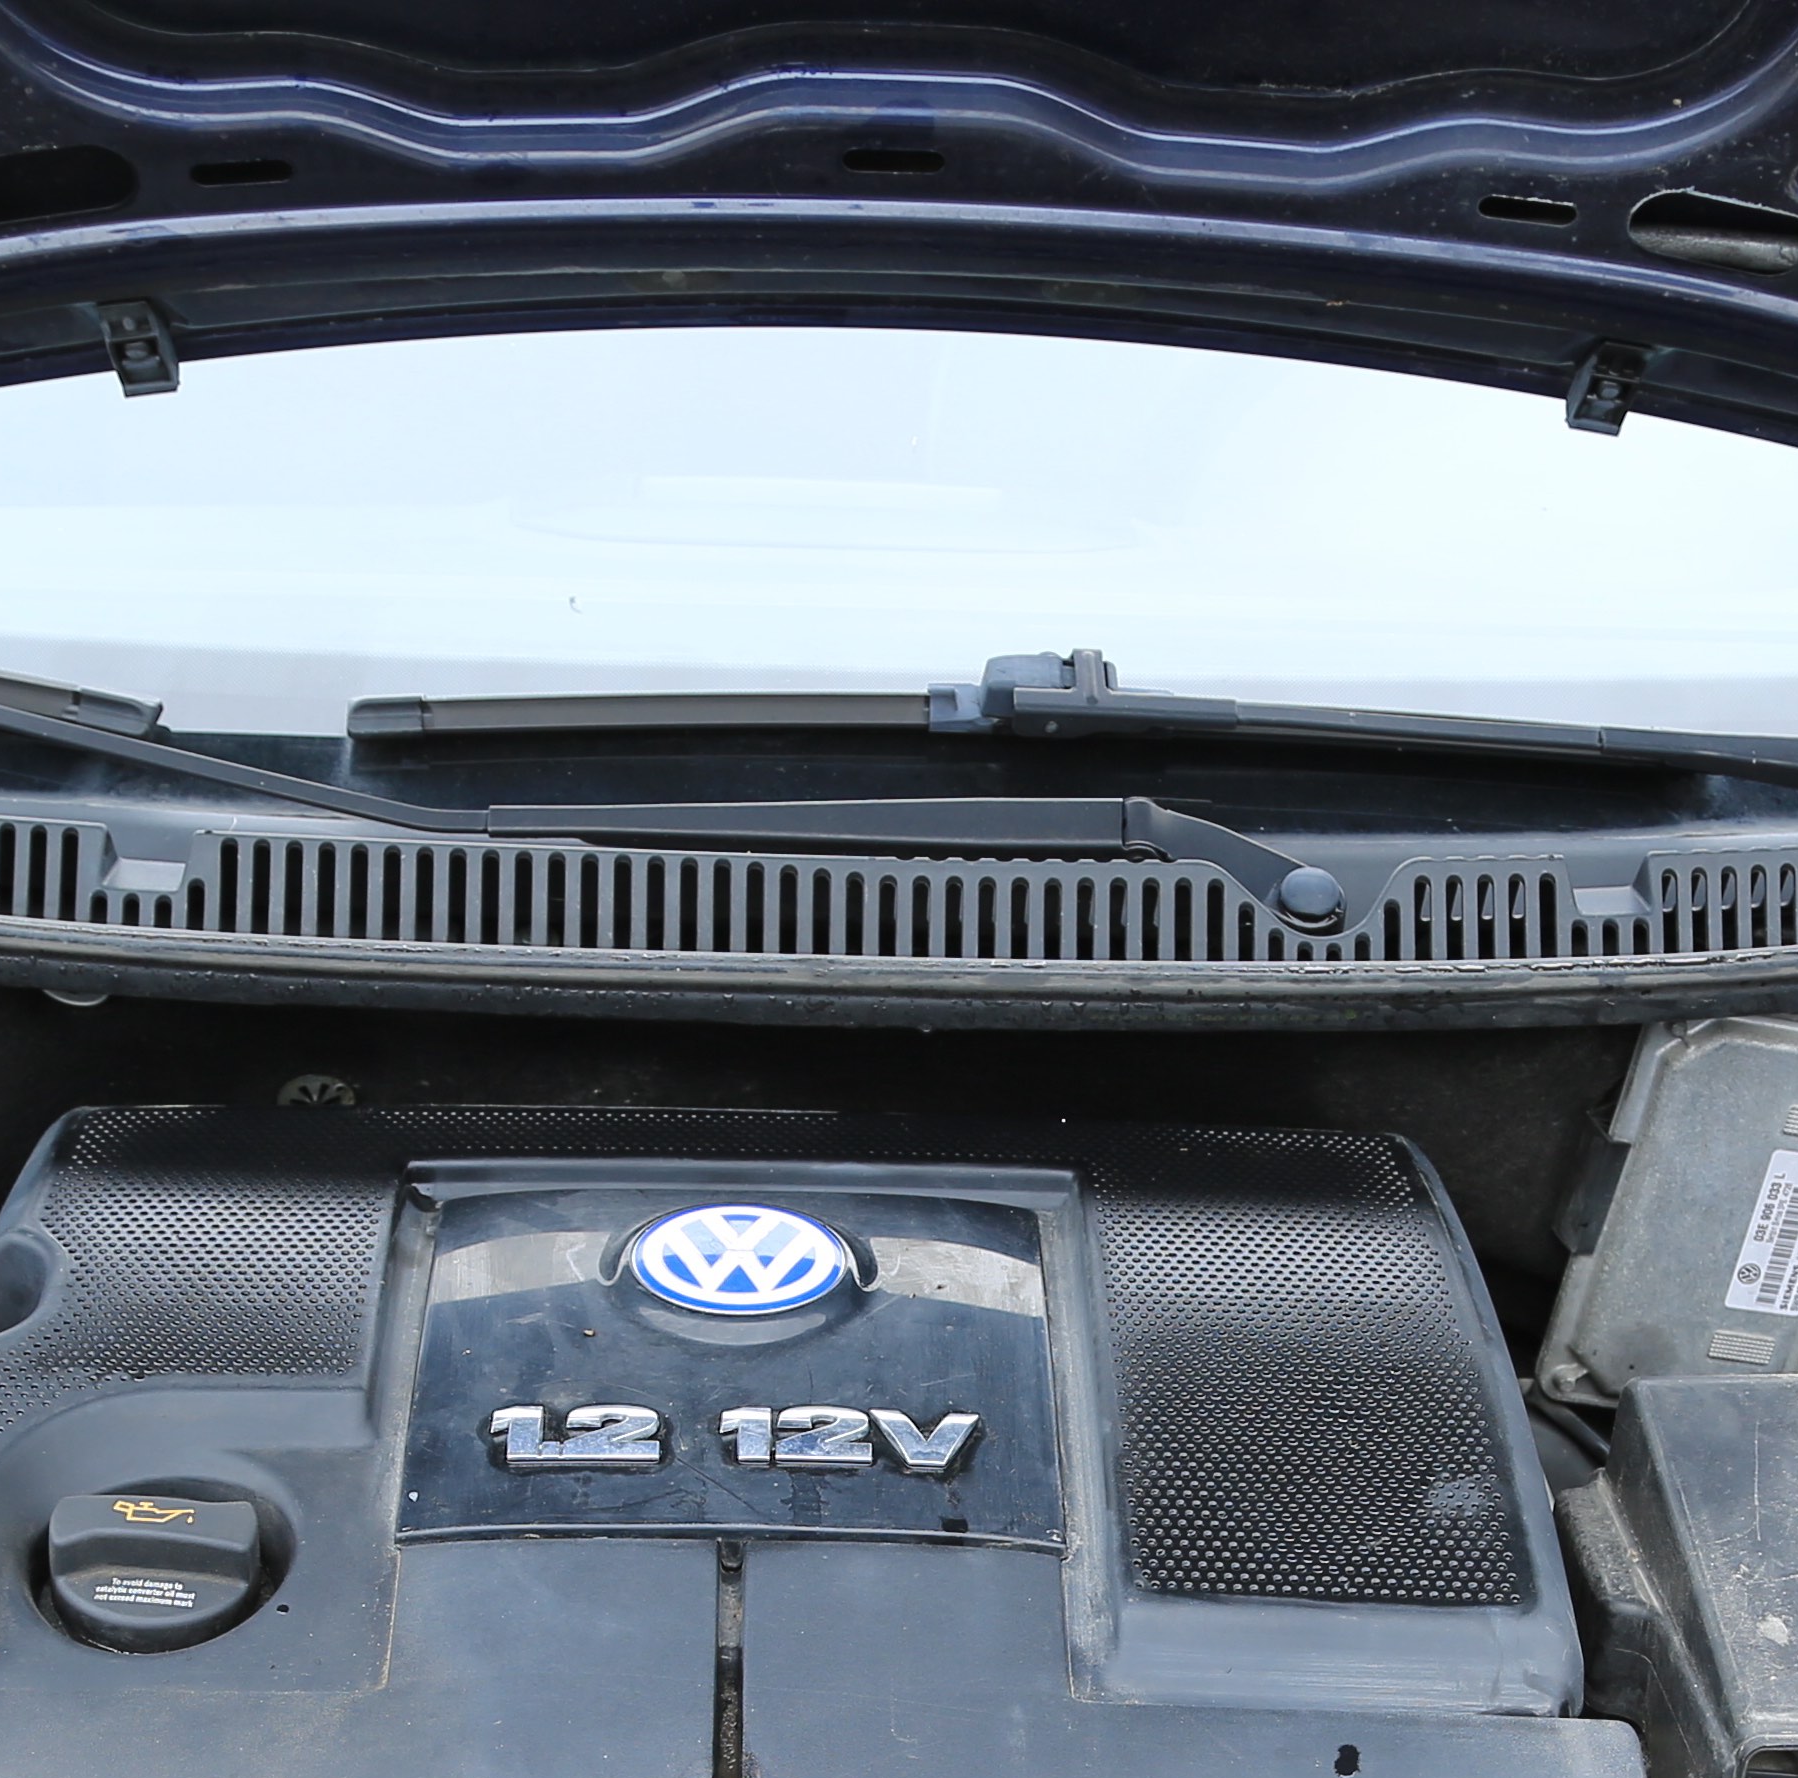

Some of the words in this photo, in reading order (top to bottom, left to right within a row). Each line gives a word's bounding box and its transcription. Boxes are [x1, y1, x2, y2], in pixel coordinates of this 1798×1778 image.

[490, 1403, 661, 1465] 1.2
[719, 1404, 980, 1469] 12V
[112, 1577, 121, 1585] To
[122, 1578, 144, 1587] avoid
[143, 1579, 173, 1591] damage
[174, 1582, 183, 1591] to
[128, 1587, 164, 1596] converter
[108, 1594, 135, 1602] exceed
[135, 1596, 173, 1606] maximum
[173, 1600, 194, 1608] mark
